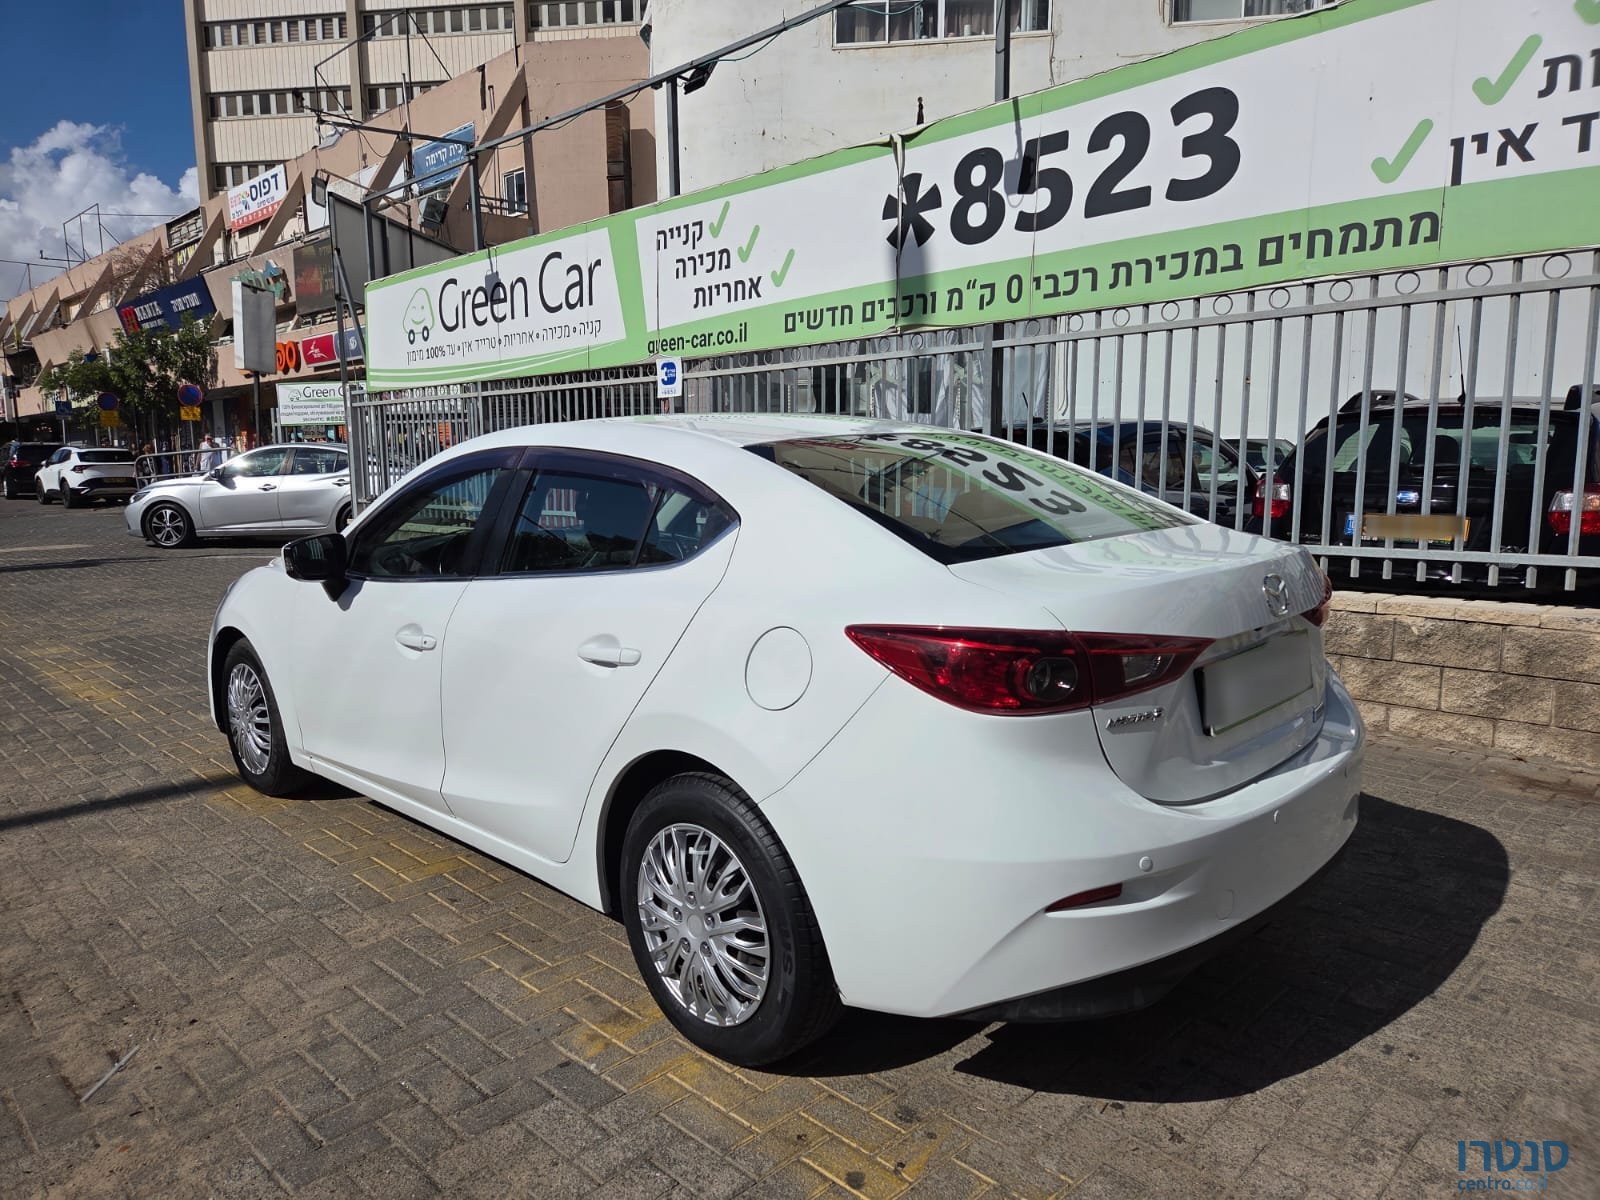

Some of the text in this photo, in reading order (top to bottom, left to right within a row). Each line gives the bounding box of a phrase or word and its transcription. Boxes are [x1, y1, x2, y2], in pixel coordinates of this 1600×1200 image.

[425, 146, 447, 167] קדימה
[1451, 123, 1539, 187] אין
[249, 173, 279, 202] דפוס
[656, 219, 704, 252] קנייה
[1258, 211, 1441, 267] מתמחים
[675, 247, 732, 279] מכירה
[1109, 243, 1244, 290] במכירת
[437, 251, 602, 334] Green Car
[693, 276, 763, 309] אחריות
[1007, 274, 1023, 304] 0
[1033, 267, 1098, 300] רכבי
[785, 305, 854, 334] חדשים
[862, 290, 937, 324] ורכבים
[406, 319, 601, 366] קניה מכירה אחריות טרייד אין עד 100% מימון
[647, 322, 748, 356] green-car.co.il
[302, 386, 336, 399] Green
